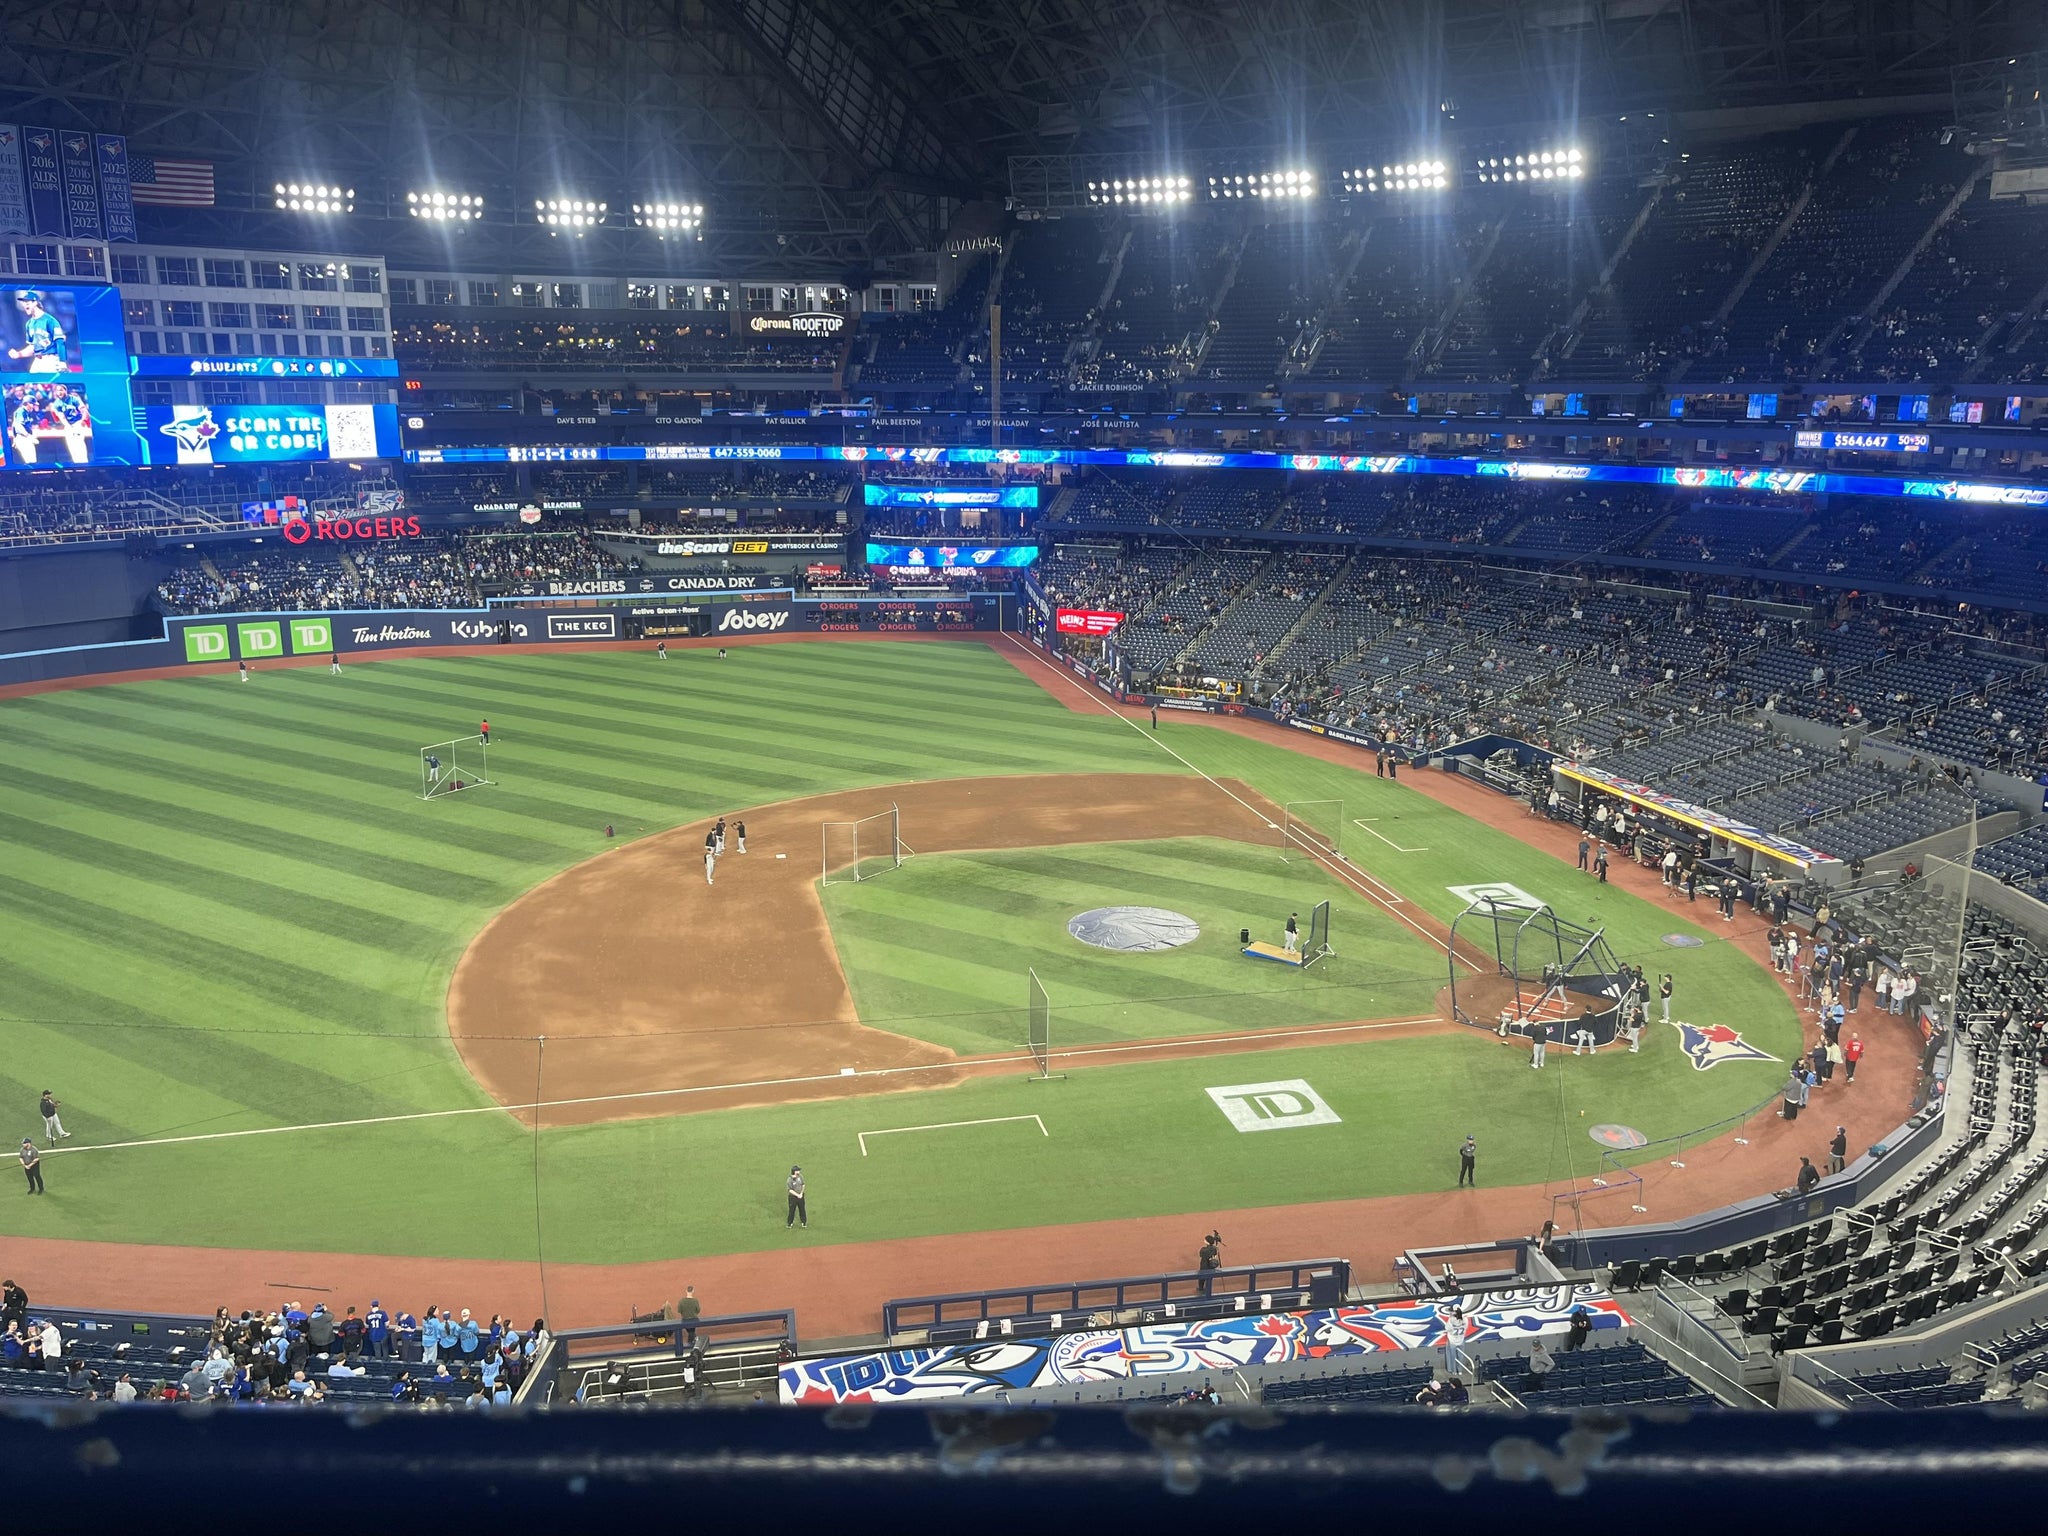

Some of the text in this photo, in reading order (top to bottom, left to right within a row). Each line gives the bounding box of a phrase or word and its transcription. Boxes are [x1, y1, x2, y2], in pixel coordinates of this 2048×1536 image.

[0, 153, 17, 165] 015
[31, 156, 55, 169] 2016
[68, 167, 91, 179] 2016
[103, 162, 126, 175] 2025
[33, 171, 57, 183] ALDS
[32, 181, 59, 192] CHAMPS
[69, 183, 94, 196] 2020
[105, 191, 129, 202] EAST
[71, 200, 96, 212] 2022
[109, 214, 133, 226] ALCS
[750, 317, 843, 332] Corona ROOFTOP
[191, 361, 258, 373] @BLUEJAYS
[226, 417, 322, 432] SCAN THE
[230, 434, 318, 451] QR CODE
[1798, 433, 1822, 441] WINNER
[1835, 434, 1888, 448] $564,647
[714, 448, 781, 458] 647-559-0060
[1162, 453, 1225, 466] WEND
[1517, 463, 1591, 479] WEND
[934, 491, 1000, 503] WEND
[1903, 482, 2048, 504] Y2K WKEND
[473, 503, 504, 511] CANADA
[543, 501, 582, 509] BLEACHERS
[318, 516, 421, 540] ROGERS
[657, 541, 730, 554] theScore
[734, 542, 767, 553] BET
[898, 566, 930, 575] ROGERS
[549, 580, 627, 595] BLEACHERS
[668, 577, 725, 590] CANADA
[632, 607, 655, 615] Active
[829, 602, 858, 610] ROGERS
[887, 602, 916, 610] ROGERS
[555, 621, 608, 631] THE KEG
[718, 608, 789, 631] Sobeys
[1059, 614, 1086, 627] HEINZ
[242, 628, 278, 651] TD
[294, 624, 329, 647] TD
[352, 627, 378, 643] Tim
[189, 632, 225, 654] TD
[1125, 694, 1146, 704] HEINZ
[1222, 704, 1246, 714] HEINZ
[1328, 730, 1368, 746] BASELINE BOX
[1222, 1089, 1316, 1120] TD
[371, 1319, 379, 1328] 11
